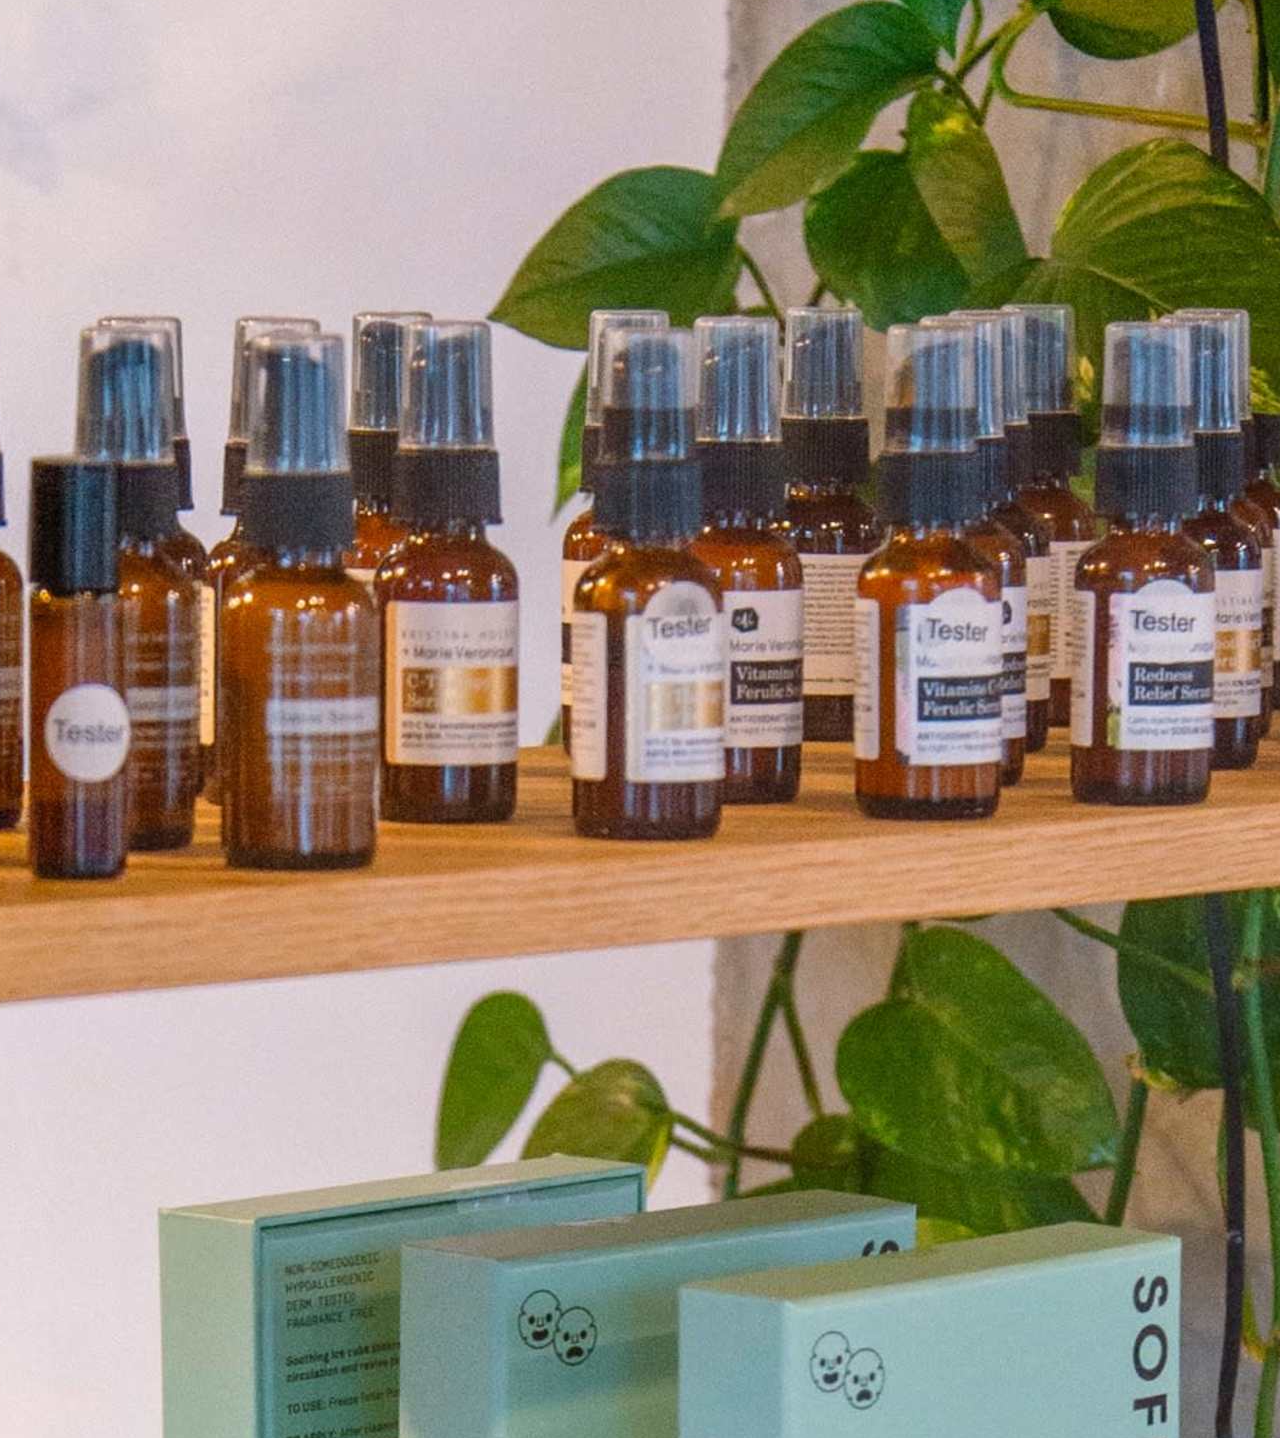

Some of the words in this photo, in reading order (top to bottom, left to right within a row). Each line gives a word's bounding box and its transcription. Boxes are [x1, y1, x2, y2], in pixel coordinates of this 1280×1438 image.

[647, 616, 712, 639] Tester
[1130, 610, 1197, 633] Tester
[927, 618, 989, 643] Tester
[414, 645, 452, 659] Marie
[730, 639, 766, 652] Marie
[1135, 666, 1194, 682] Redness
[1134, 685, 1176, 701] Relief
[925, 699, 974, 716] Ferulic
